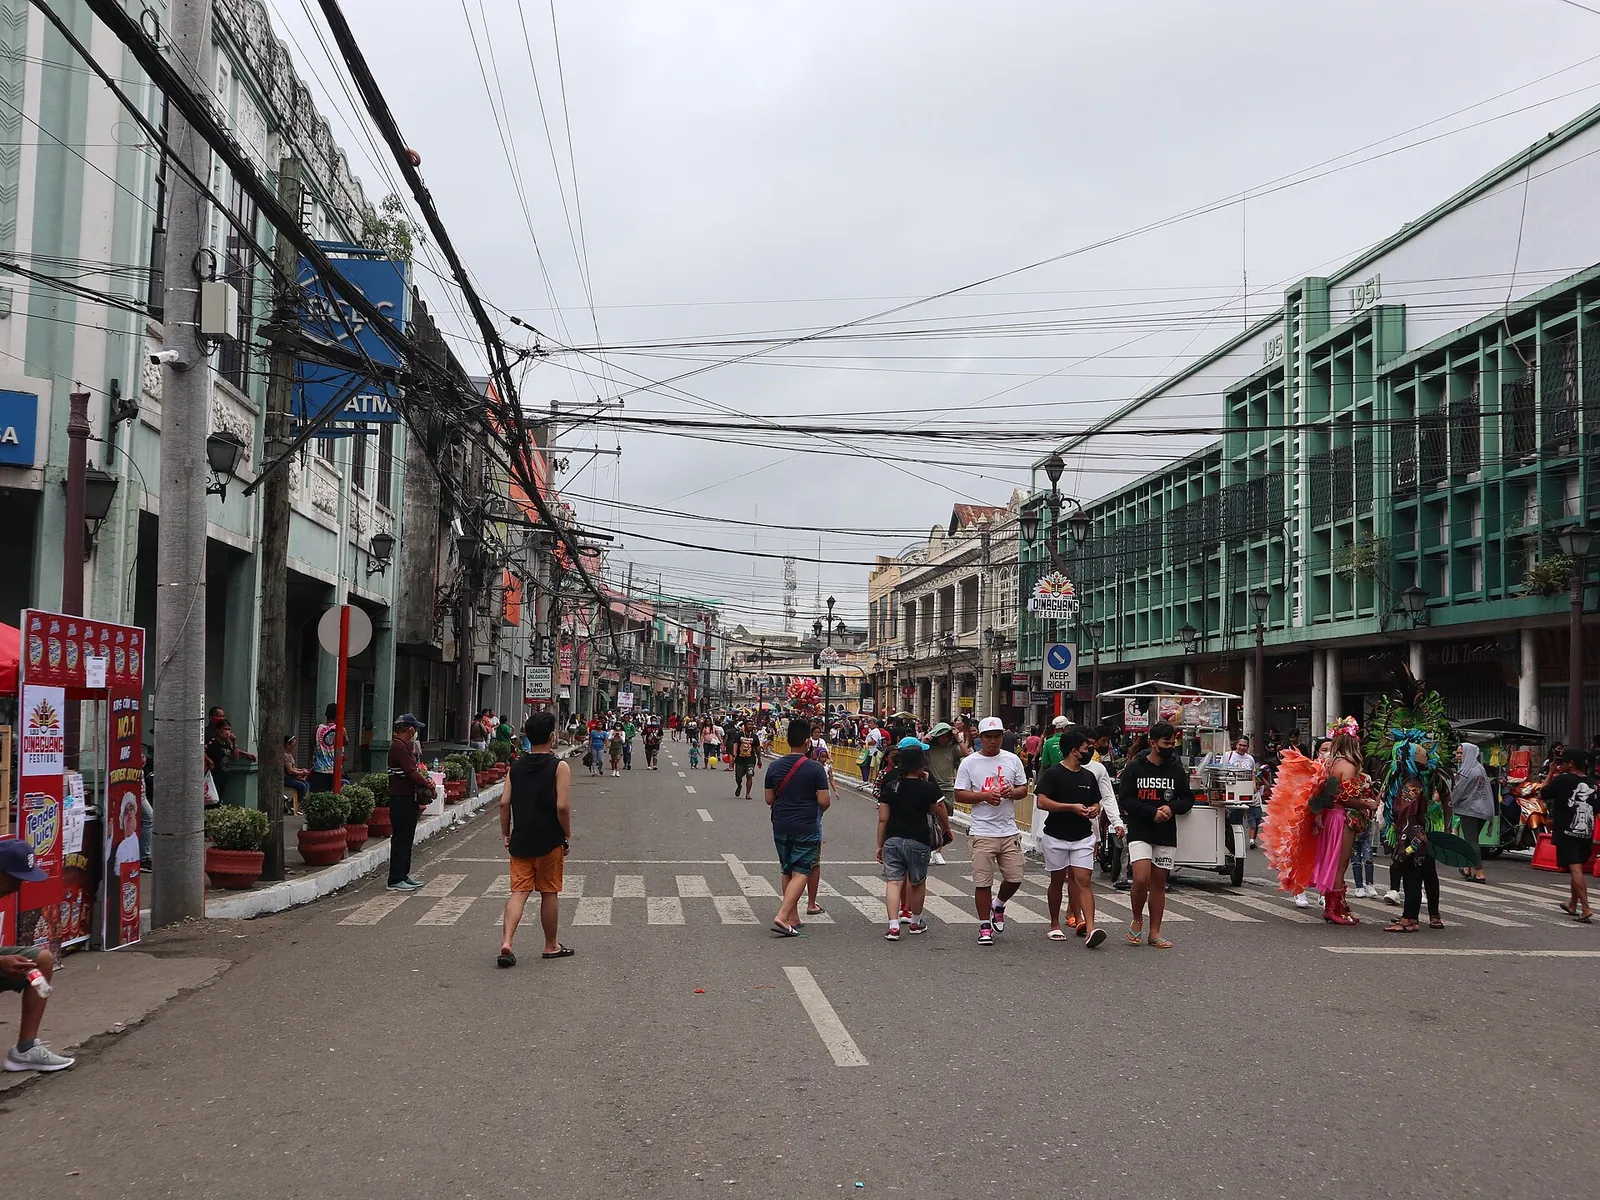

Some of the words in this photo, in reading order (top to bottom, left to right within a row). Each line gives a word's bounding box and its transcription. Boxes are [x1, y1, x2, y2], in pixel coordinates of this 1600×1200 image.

[1349, 274, 1382, 314] 1951
[343, 395, 392, 413] ATM
[1039, 611, 1072, 619] FESTIVAL
[1049, 671, 1069, 680] KEEP
[1047, 680, 1071, 689] RIGHT
[29, 753, 58, 763] FESTIVAL
[1136, 777, 1175, 790] RUSSELL
[27, 802, 58, 835] Tender
[32, 822, 54, 850] Juicy
